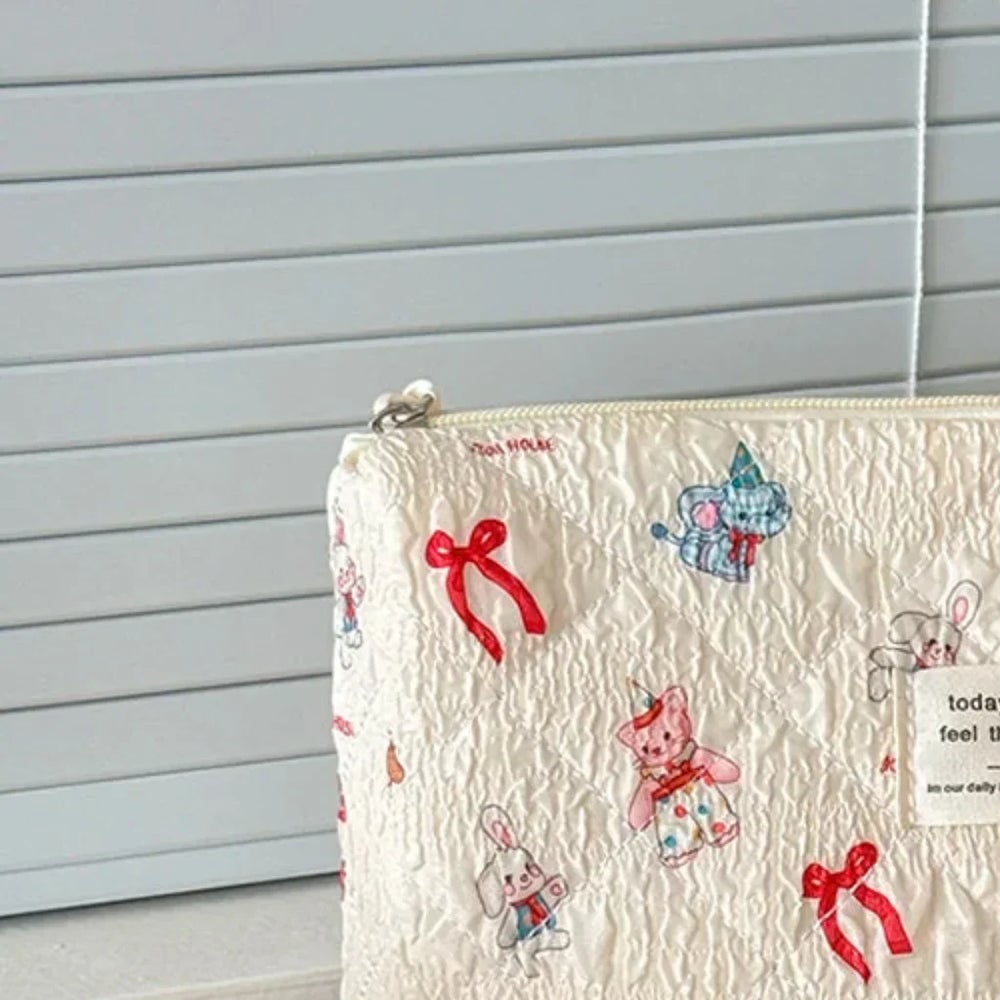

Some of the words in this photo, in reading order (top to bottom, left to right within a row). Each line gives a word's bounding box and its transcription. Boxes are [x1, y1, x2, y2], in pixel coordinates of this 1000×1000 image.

[939, 725, 978, 742] feel
[943, 783, 964, 793] our
[967, 781, 996, 795] daily
